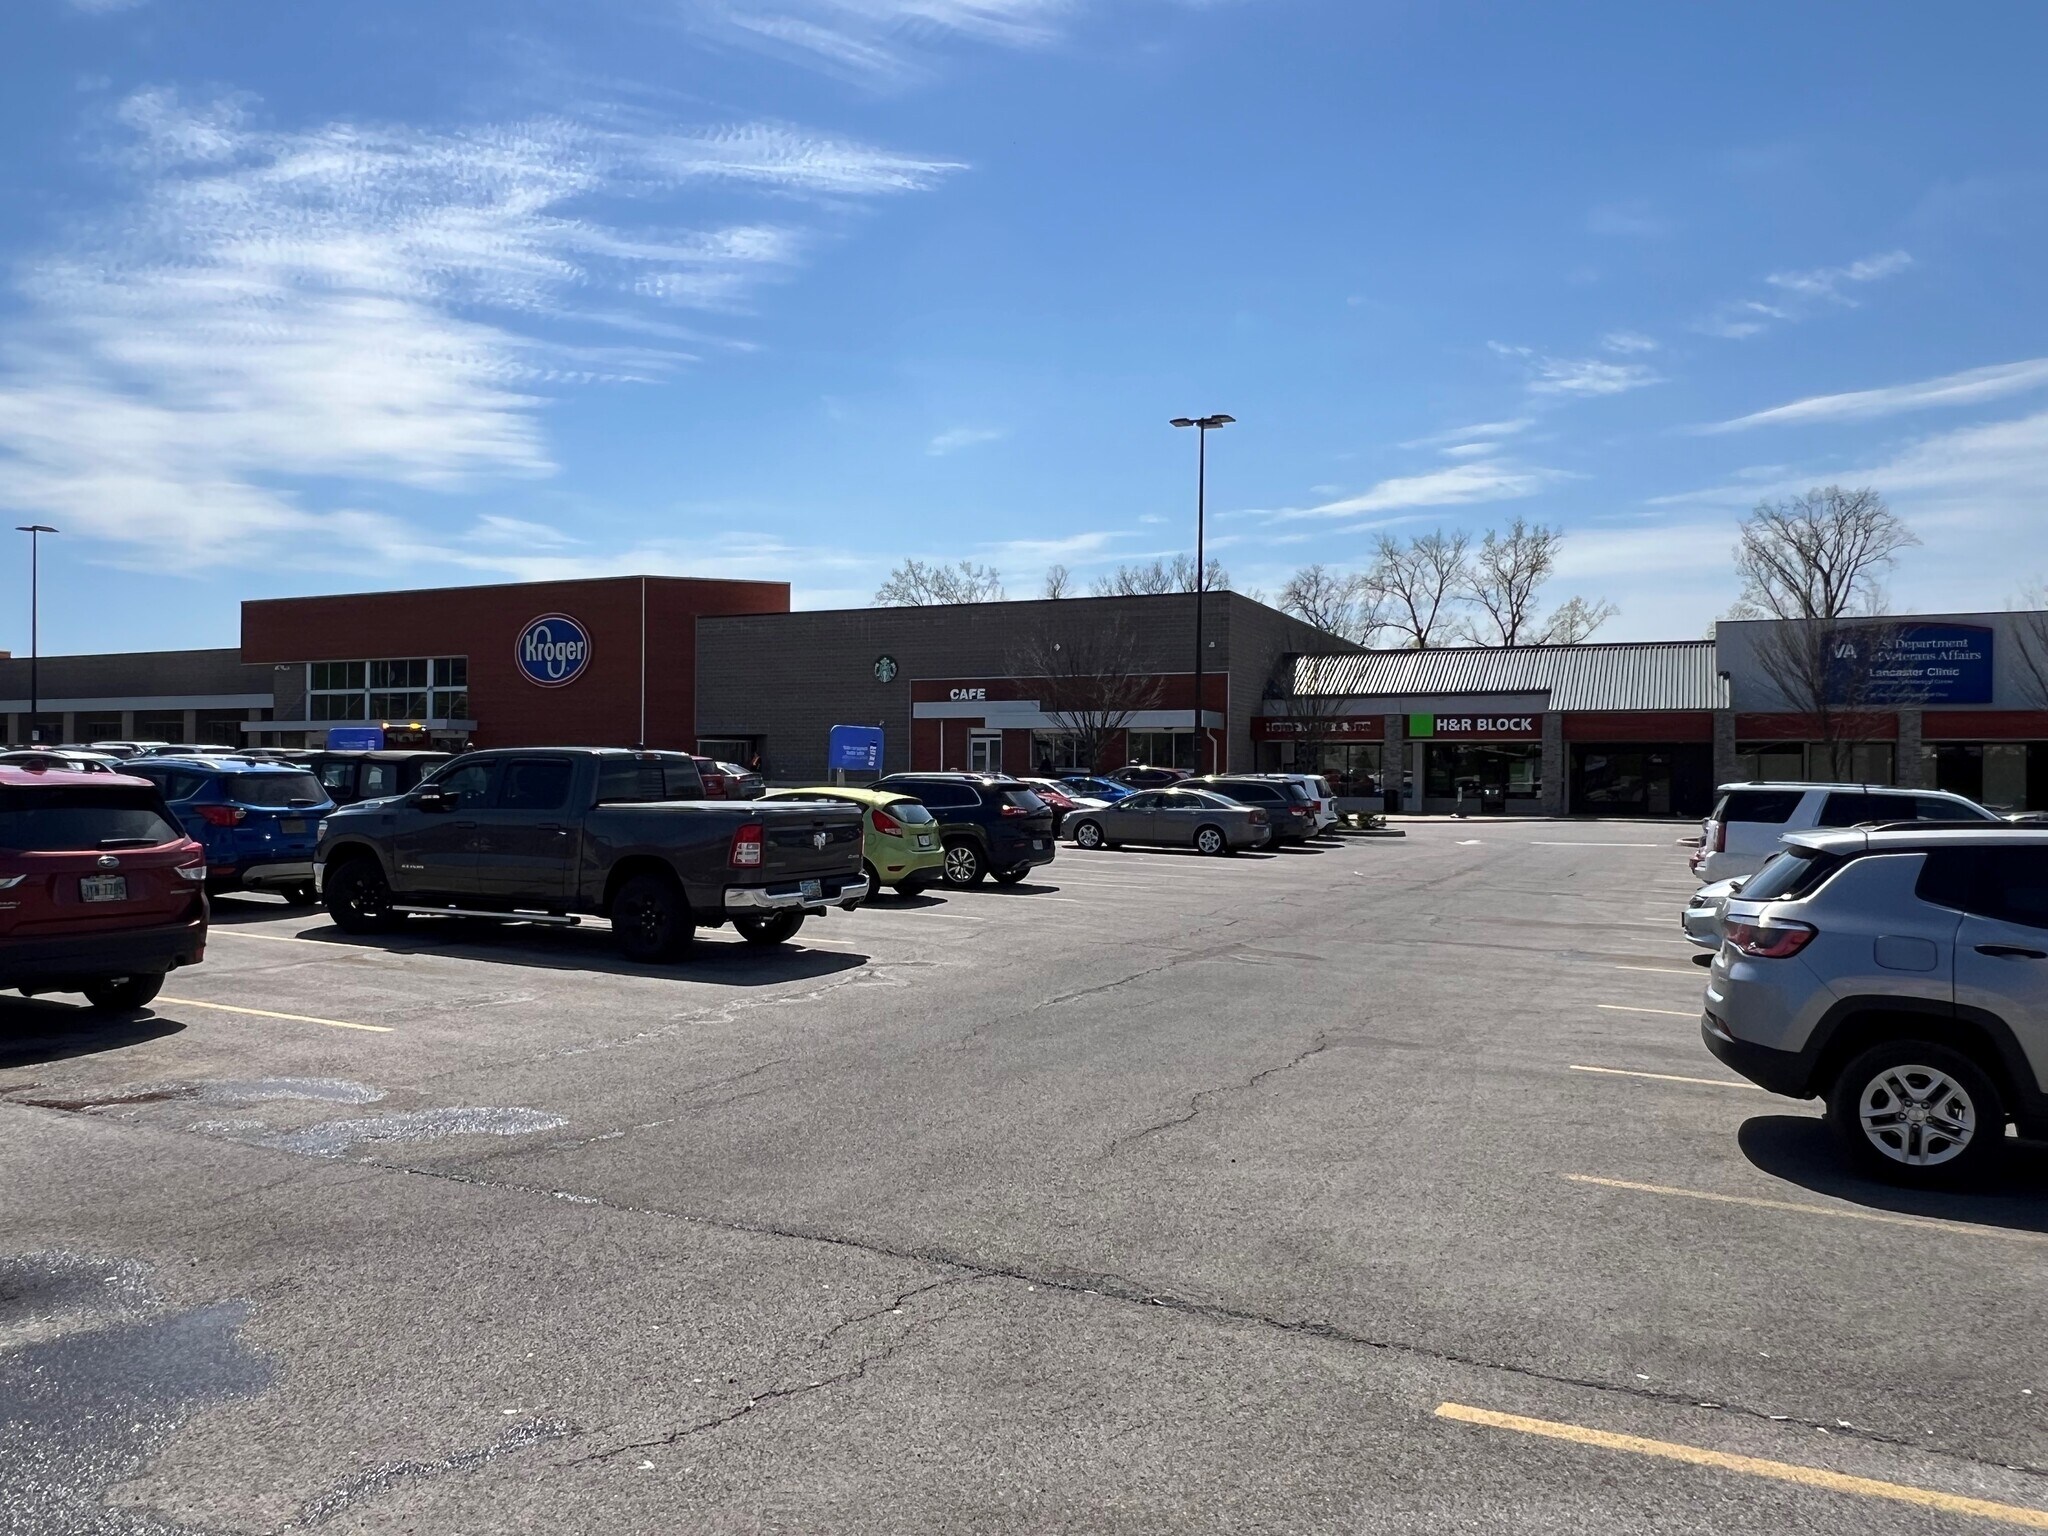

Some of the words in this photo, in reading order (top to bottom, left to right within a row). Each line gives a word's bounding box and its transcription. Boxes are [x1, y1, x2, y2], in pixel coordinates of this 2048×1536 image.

[1895, 639, 1968, 651] Department
[525, 625, 584, 679] Kroger
[1938, 650, 1982, 661] Affairs
[1869, 668, 1923, 677] Lancaster
[1927, 667, 1960, 677] Clinic
[950, 688, 986, 700] CAFE
[1436, 718, 1472, 731] H&R
[1477, 717, 1533, 731] BLOCK
